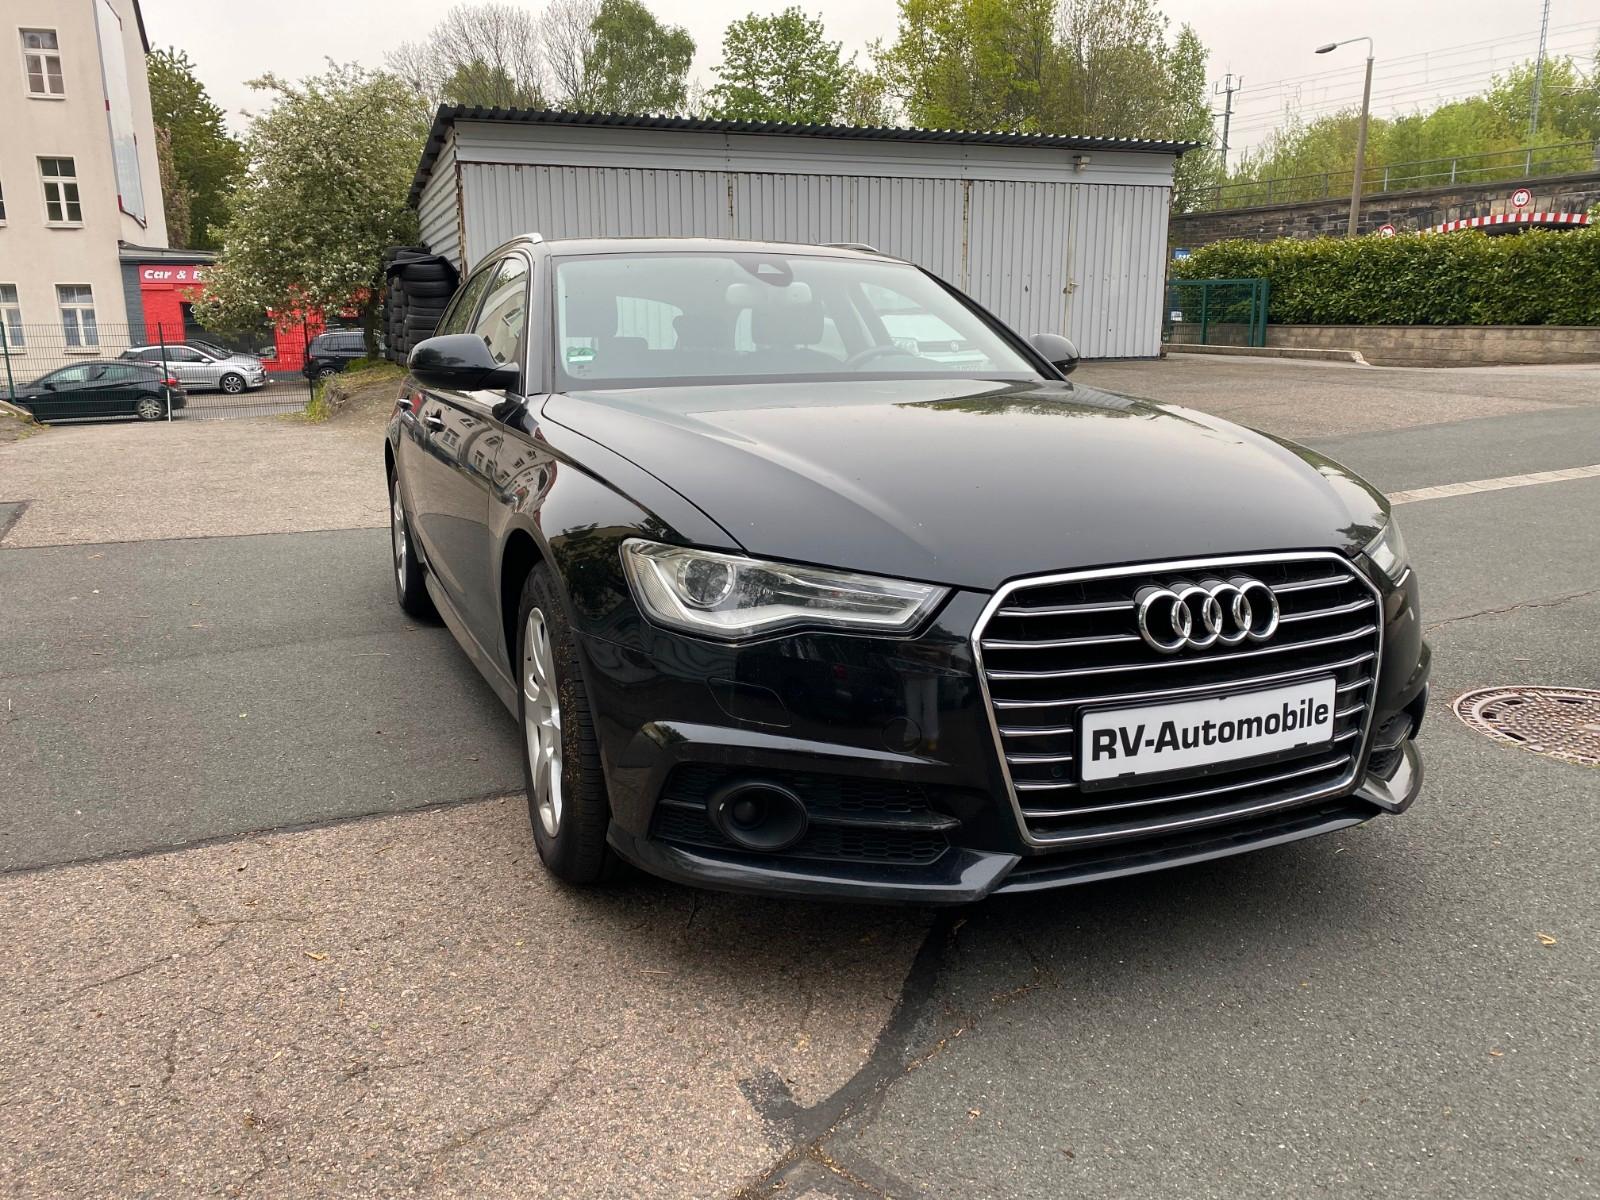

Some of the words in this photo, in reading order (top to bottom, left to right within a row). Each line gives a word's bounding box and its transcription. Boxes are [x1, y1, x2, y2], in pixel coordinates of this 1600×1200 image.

[144, 269, 172, 279] Car
[176, 270, 187, 280] &
[1091, 697, 1329, 761] RV-Automobile
